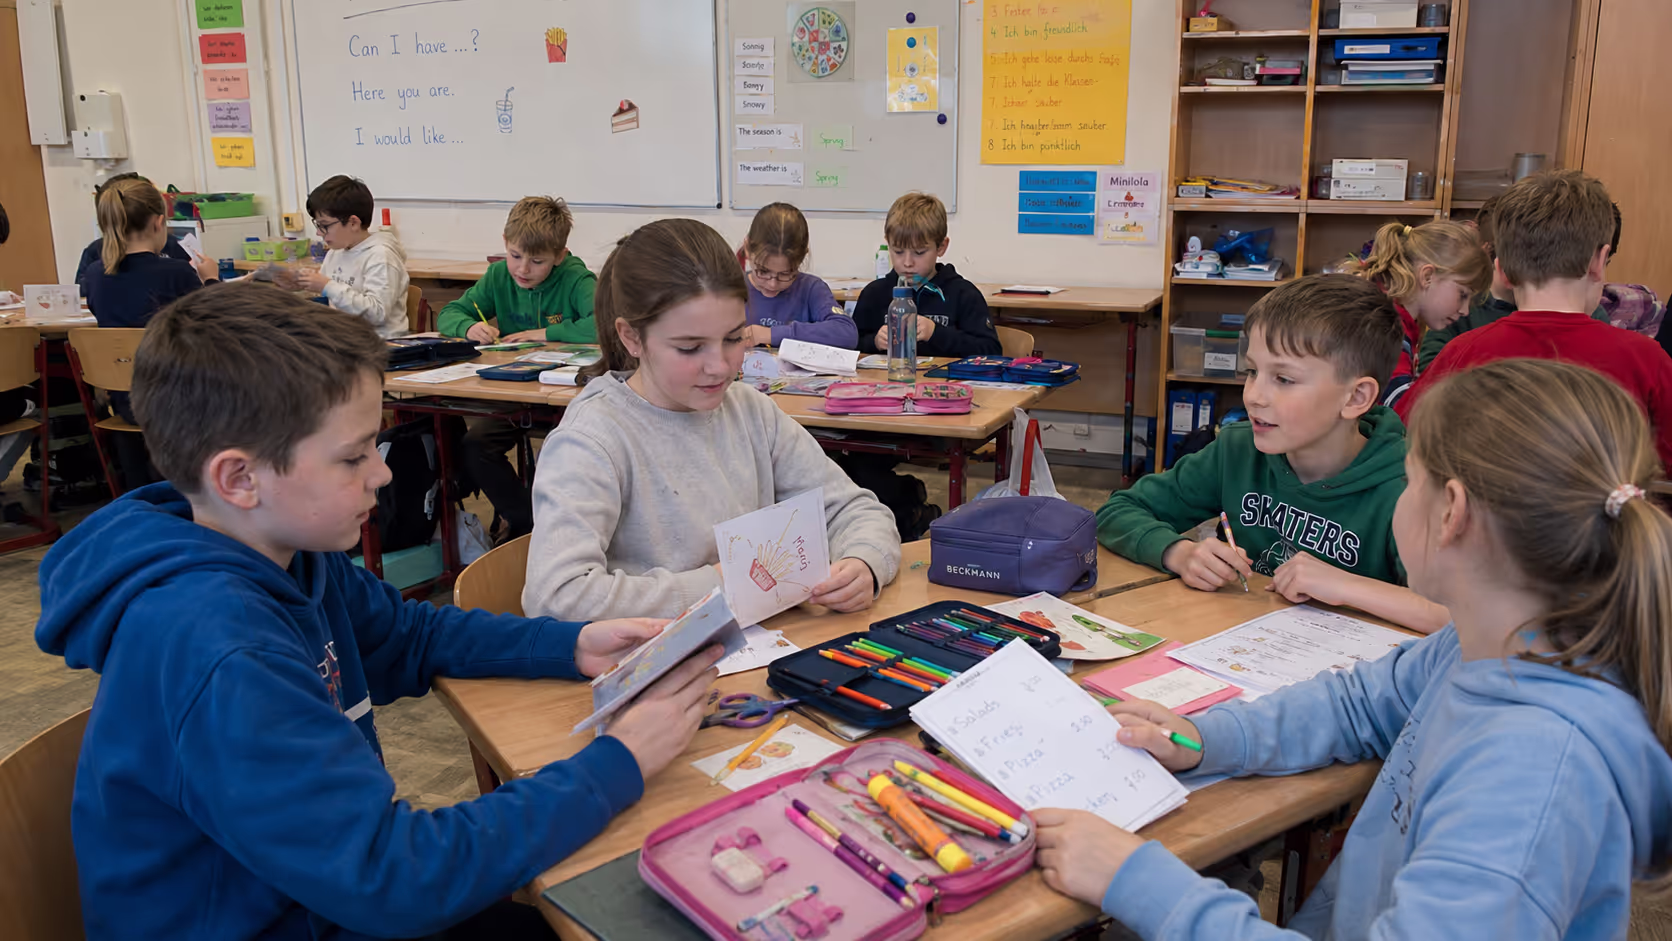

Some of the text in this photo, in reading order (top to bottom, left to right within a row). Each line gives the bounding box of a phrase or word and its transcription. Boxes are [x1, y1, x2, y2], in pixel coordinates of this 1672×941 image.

[1004, 25, 1019, 38] Ich
[1025, 24, 1038, 37] bin
[348, 34, 379, 57] Can
[390, 34, 401, 55] I
[415, 31, 447, 54] have
[1003, 75, 1017, 88] Ich
[1047, 73, 1059, 87] die
[352, 80, 455, 111] Here you are.
[742, 101, 766, 110] Snowy
[738, 127, 751, 136] The
[776, 127, 782, 136] is
[1002, 118, 1016, 131] Ich
[355, 127, 365, 145] I
[374, 126, 412, 145] would
[422, 125, 447, 145] like
[988, 138, 995, 151] 8
[1002, 138, 1017, 151] Ich
[1021, 138, 1035, 151] bin
[739, 164, 787, 173] The weather is
[1110, 176, 1149, 187] Minilola
[1240, 492, 1361, 568] SKATERS
[946, 564, 1001, 580] BECKMANN
[953, 700, 1000, 729] Salads
[1004, 748, 1044, 773] Pizza
